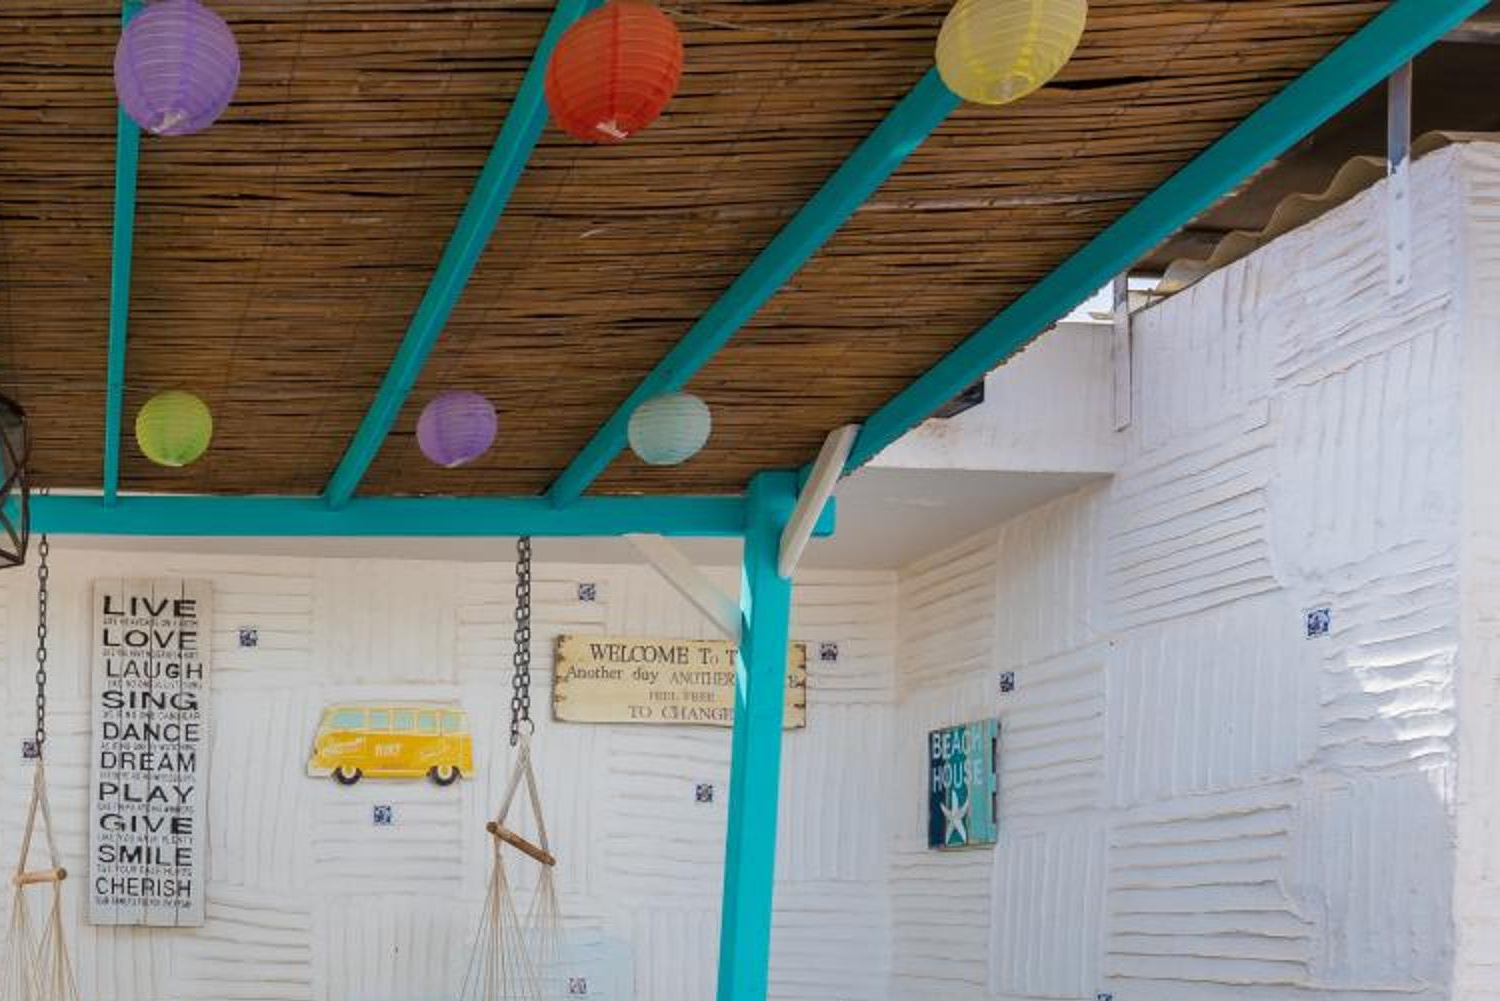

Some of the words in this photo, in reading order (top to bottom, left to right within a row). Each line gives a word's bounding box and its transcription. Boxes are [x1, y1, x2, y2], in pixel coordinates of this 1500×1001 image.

[103, 595, 197, 618] LIVE
[103, 628, 197, 650] LOVE
[590, 643, 689, 665] WELCOME
[106, 659, 203, 679] LAUGH
[568, 663, 624, 681] Another
[633, 664, 659, 685] day
[101, 689, 198, 710] SING
[628, 705, 653, 719] TO
[102, 721, 200, 742] DANCE
[932, 730, 982, 759] BEACH
[101, 751, 196, 772] DREAM
[932, 759, 982, 793] HOUSE
[99, 781, 194, 803] PLAY
[99, 813, 193, 834] GIVE
[98, 844, 193, 866] SMILE
[95, 876, 192, 898] CHERISH
